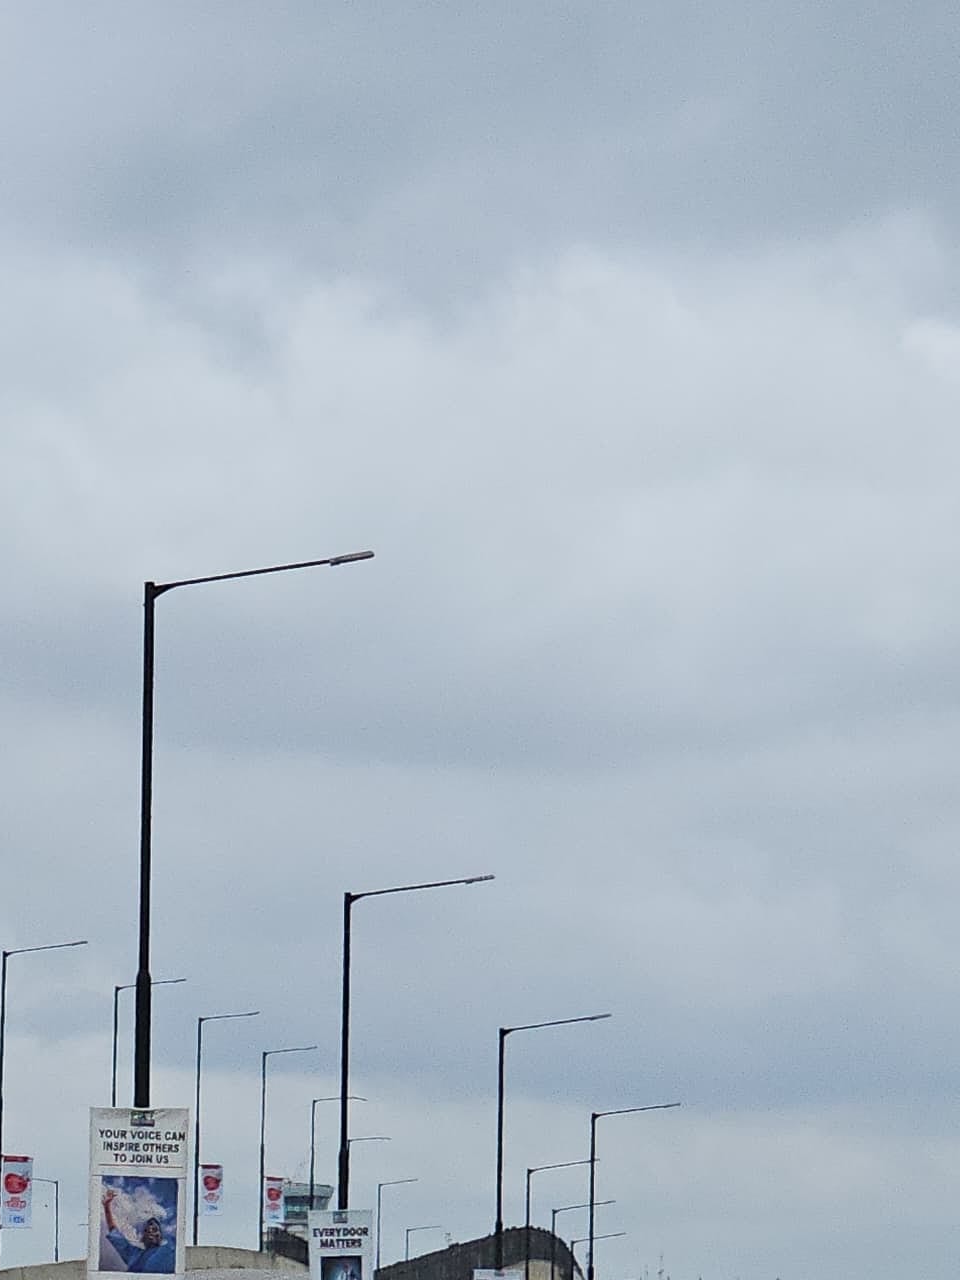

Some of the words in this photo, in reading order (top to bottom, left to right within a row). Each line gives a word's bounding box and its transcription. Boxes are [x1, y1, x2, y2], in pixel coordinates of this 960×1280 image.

[98, 1129, 127, 1139] YOUR
[130, 1130, 161, 1140] VOICE
[164, 1131, 186, 1141] CAN
[103, 1142, 140, 1152] INSPIRE
[142, 1143, 179, 1153] OTHERS
[113, 1153, 127, 1163] TO
[129, 1154, 152, 1163] JOIN
[156, 1155, 169, 1164] US
[312, 1227, 340, 1238] EVERY
[342, 1227, 368, 1237] DOOR
[320, 1238, 362, 1249] MATTERS
